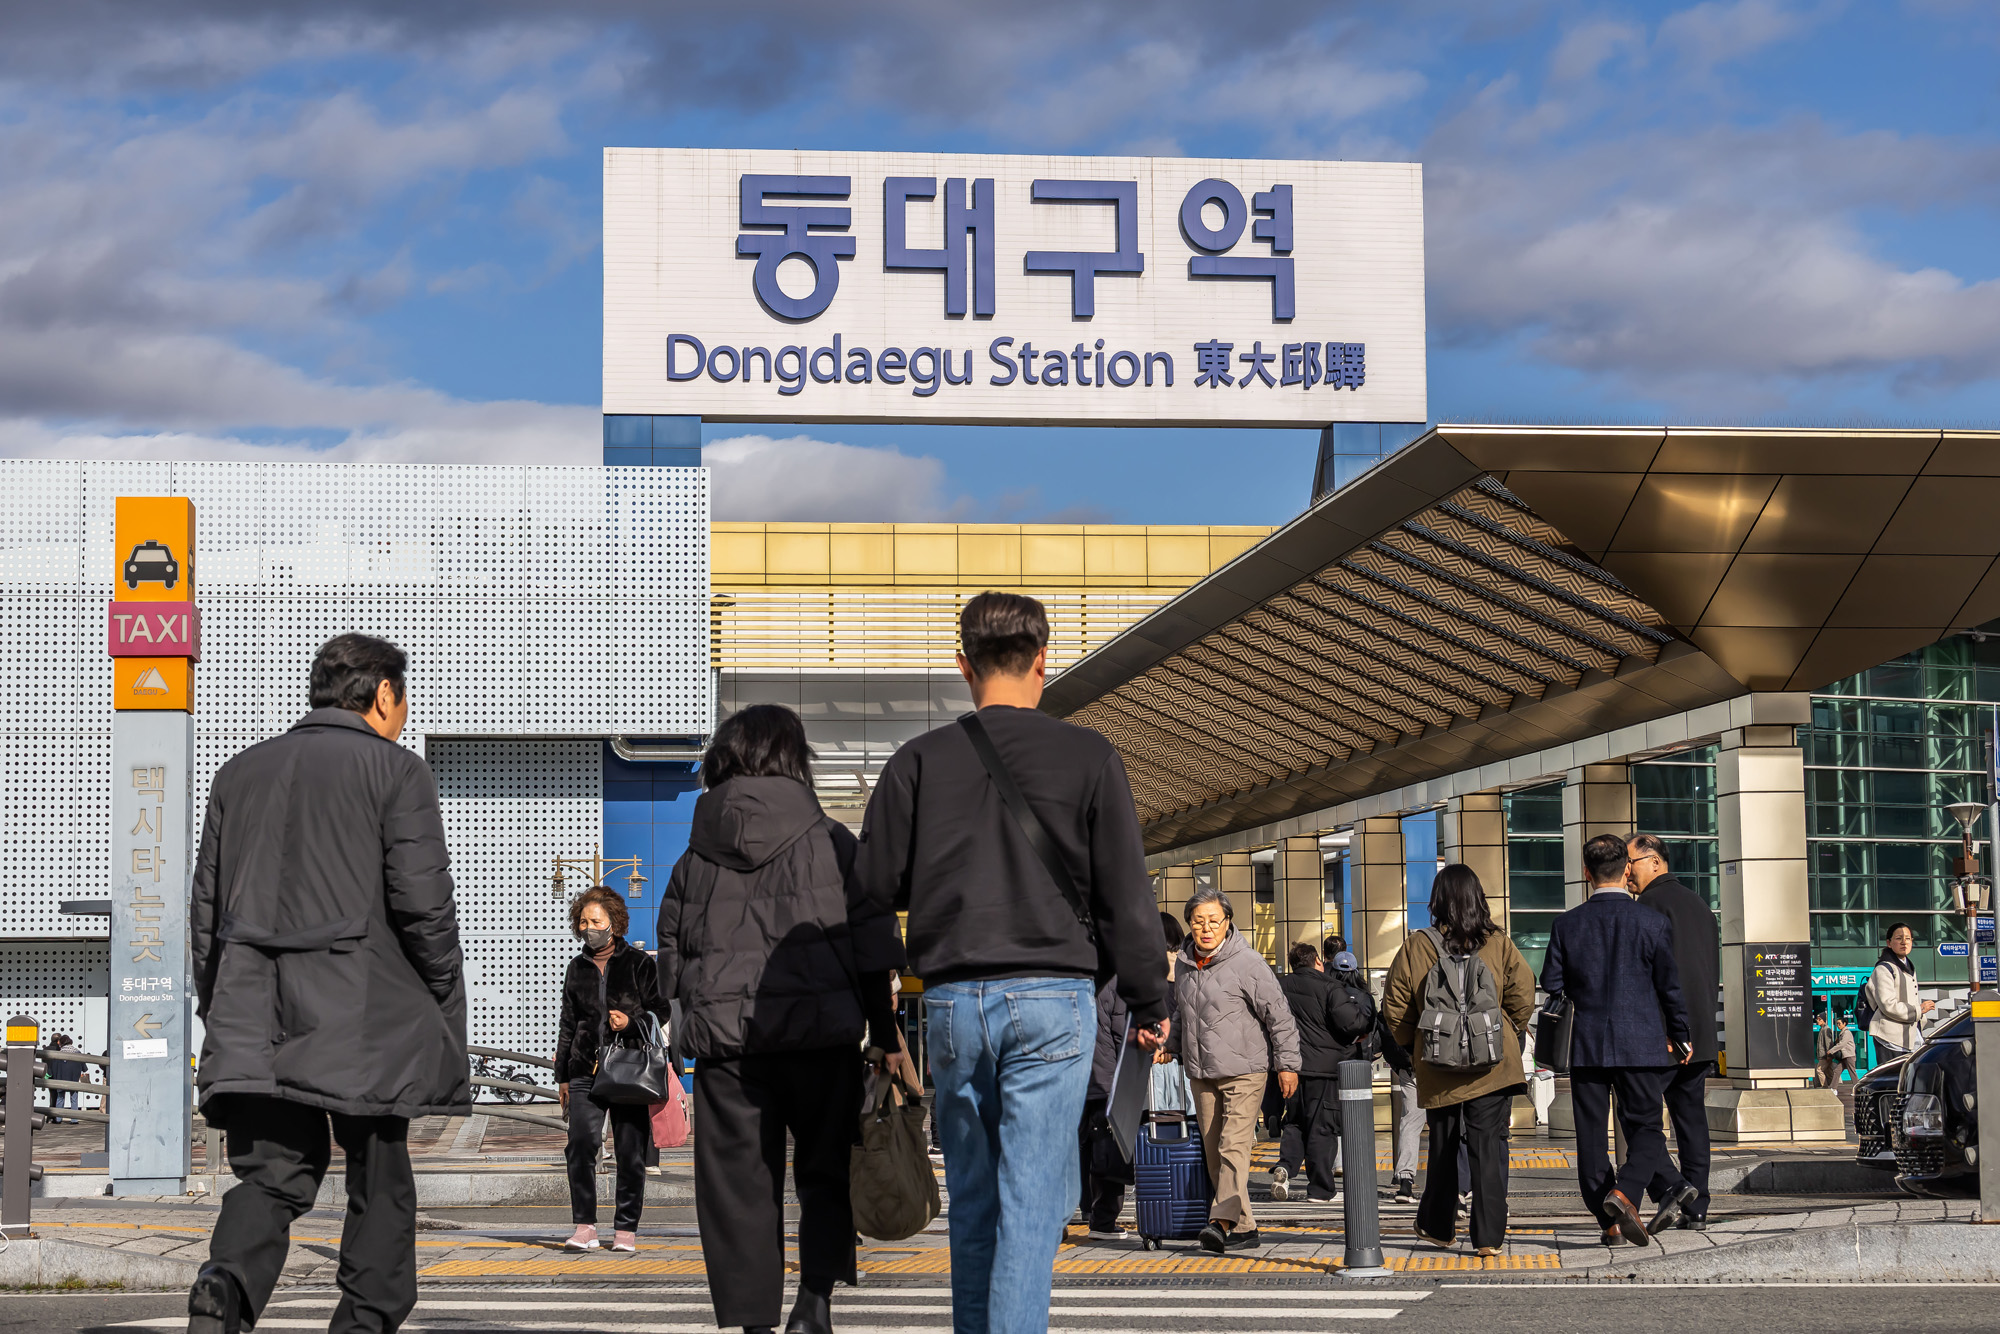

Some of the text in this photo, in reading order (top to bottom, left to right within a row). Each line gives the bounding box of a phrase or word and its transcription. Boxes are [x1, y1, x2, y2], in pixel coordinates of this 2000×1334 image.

[737, 174, 1294, 320] 동대구역
[667, 334, 1366, 394] Dongdaegu Station 東大邱驛
[113, 614, 188, 643] TAXI
[119, 993, 175, 1002] Dongdaegu Stn.
[121, 976, 172, 991] 동대구역
